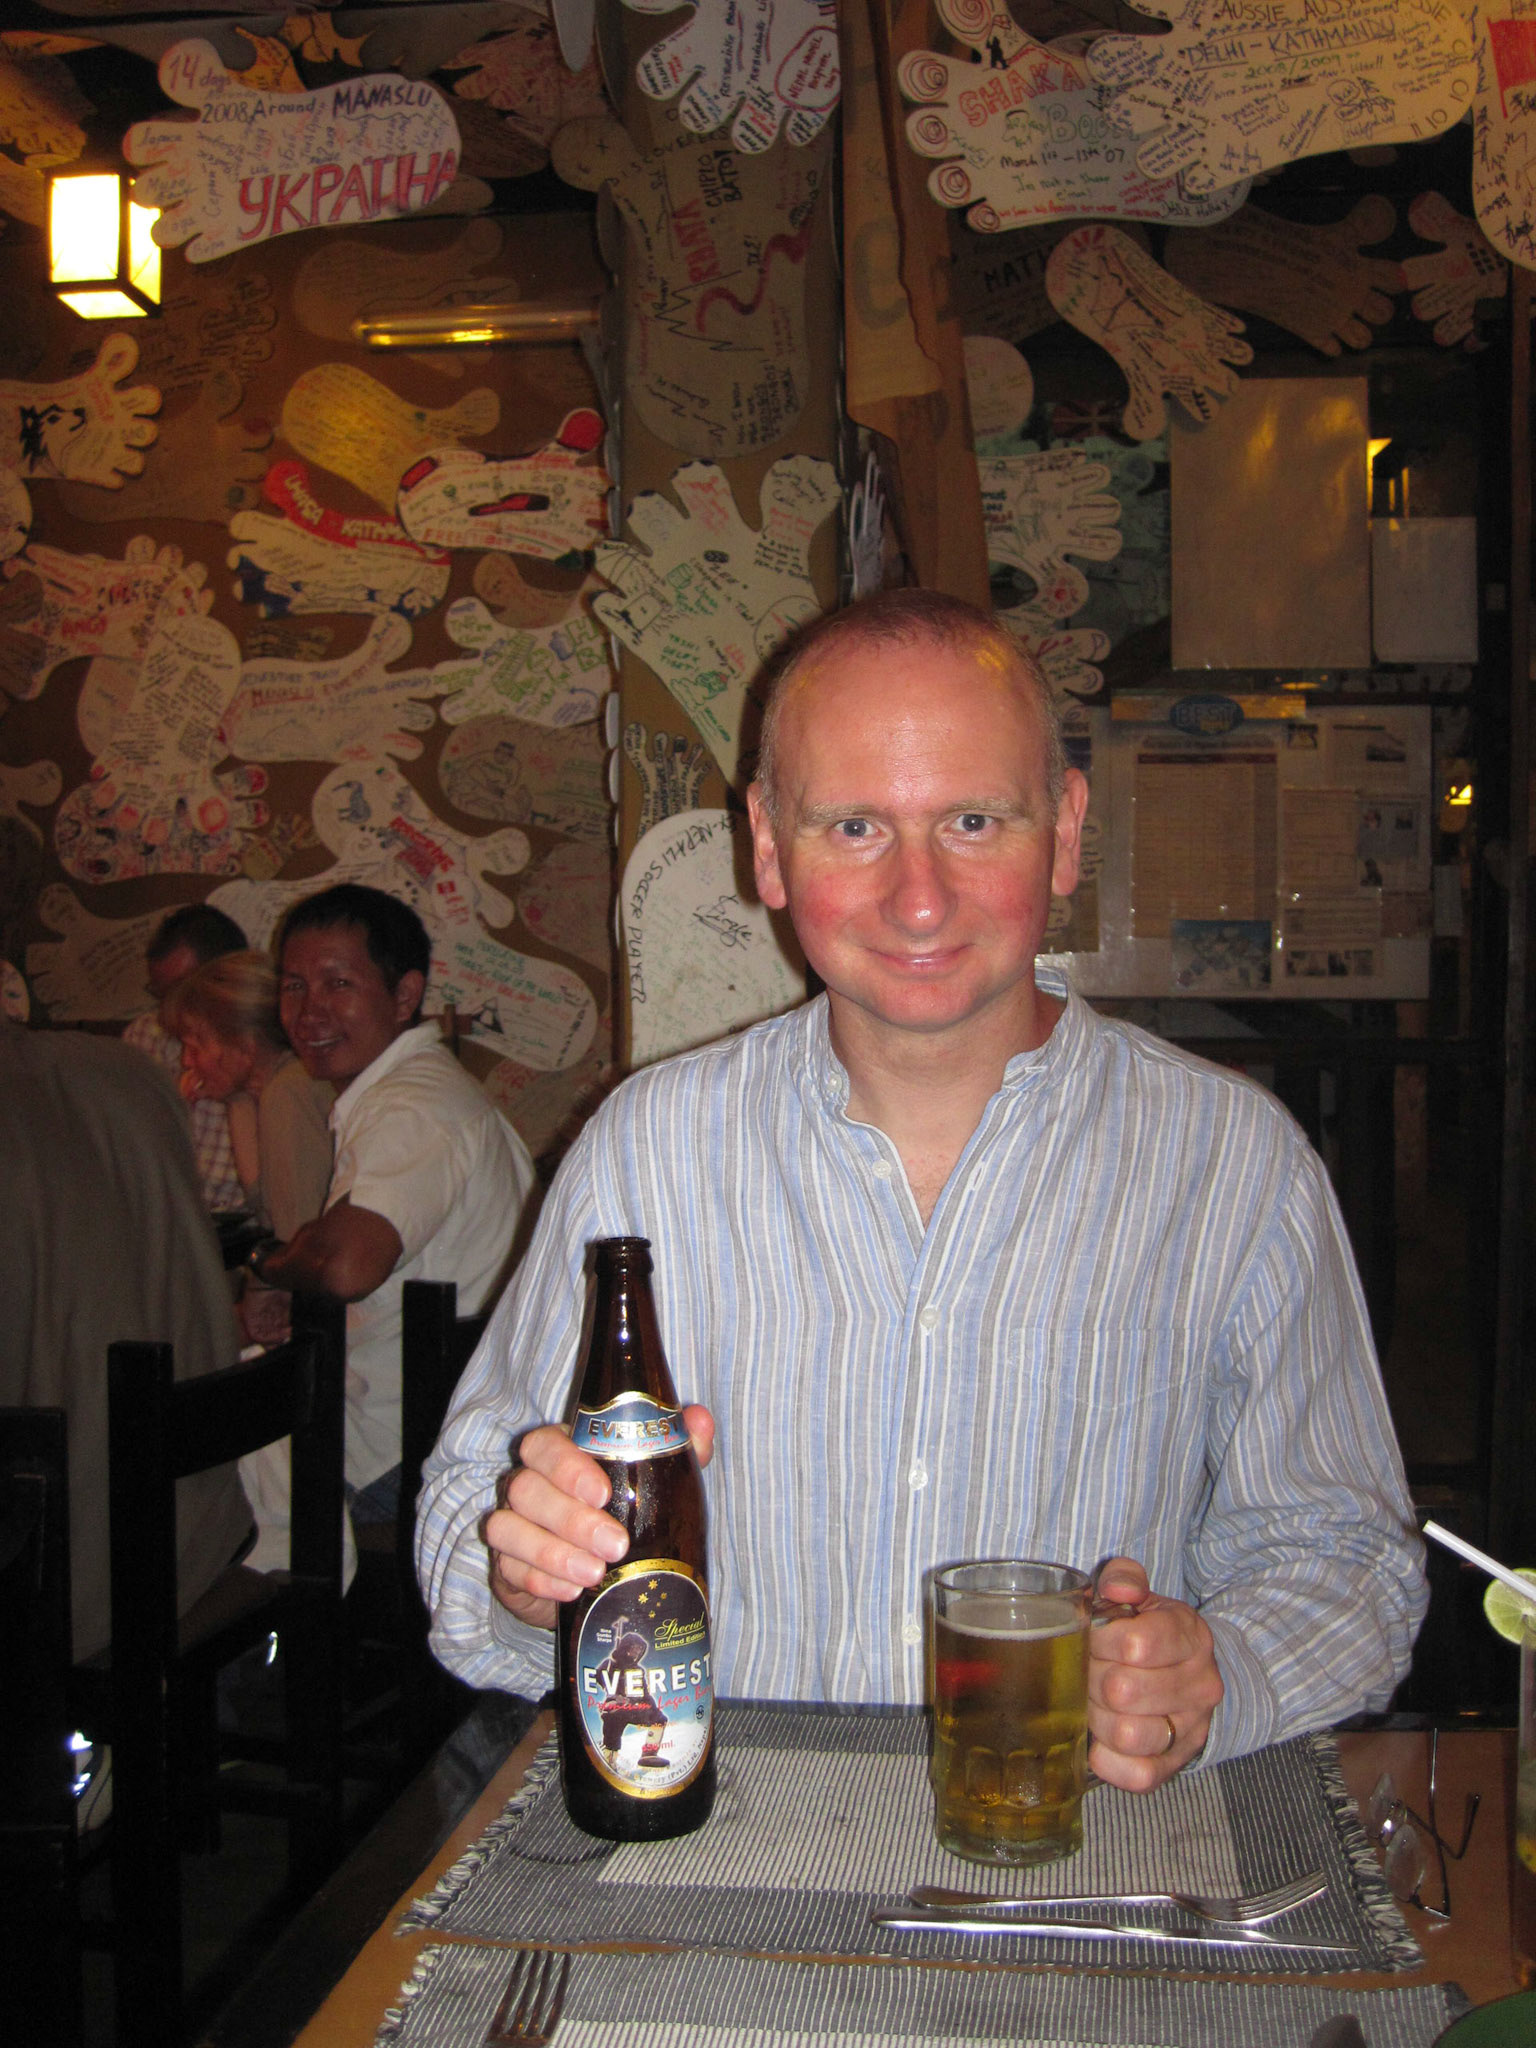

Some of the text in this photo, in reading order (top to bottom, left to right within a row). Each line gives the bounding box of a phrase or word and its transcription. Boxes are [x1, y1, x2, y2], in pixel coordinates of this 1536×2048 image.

[1185, 40, 1248, 66] DELHI
[1267, 14, 1397, 57] KATHMANDU
[169, 54, 232, 93] 14 days
[253, 97, 315, 121] Around
[332, 86, 434, 119] MANASLU
[959, 62, 1087, 128] SHAKA
[632, 859, 664, 920] SOCCER
[628, 925, 649, 1005] PLAYER
[587, 1412, 680, 1440] EVEREST
[654, 1631, 707, 1650] Limited Edition
[655, 1611, 706, 1642] Special
[582, 1652, 712, 1699] EVEREST
[587, 1695, 652, 1711] Premium
[657, 1694, 692, 1712] Lager
